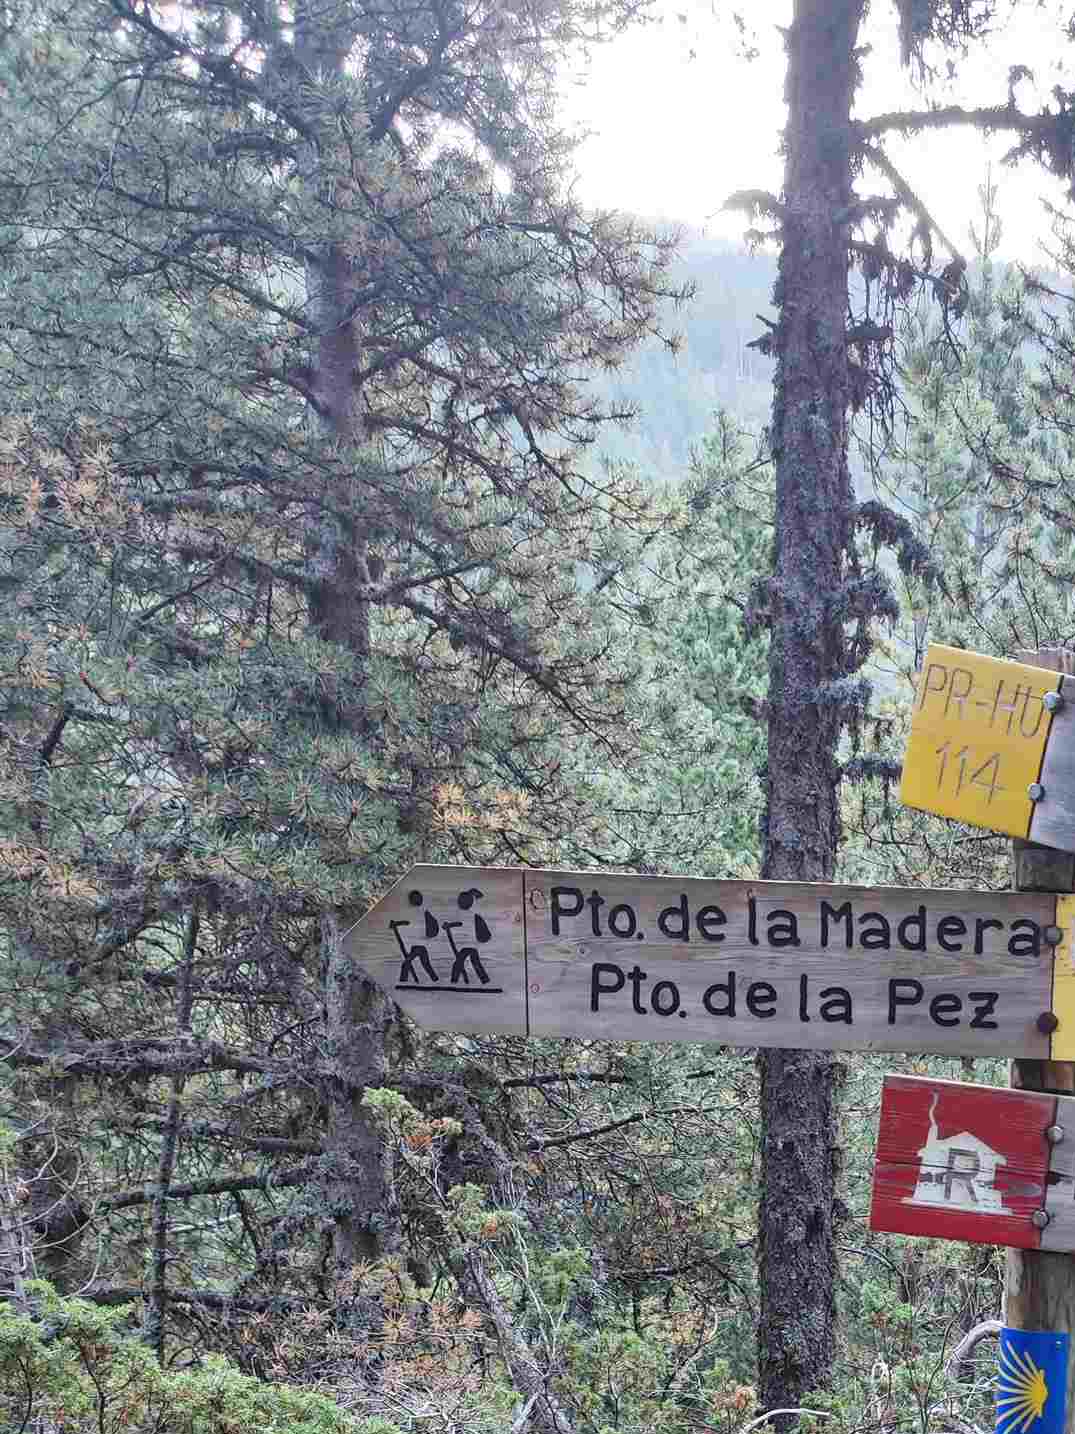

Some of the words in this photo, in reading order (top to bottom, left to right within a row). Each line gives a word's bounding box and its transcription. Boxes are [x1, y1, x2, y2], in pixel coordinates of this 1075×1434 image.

[934, 740, 1005, 806] 114
[747, 894, 801, 948] la
[818, 901, 1042, 957] Madera
[799, 973, 853, 1025] la
[887, 977, 999, 1030] Pez
[943, 1148, 979, 1202] R
